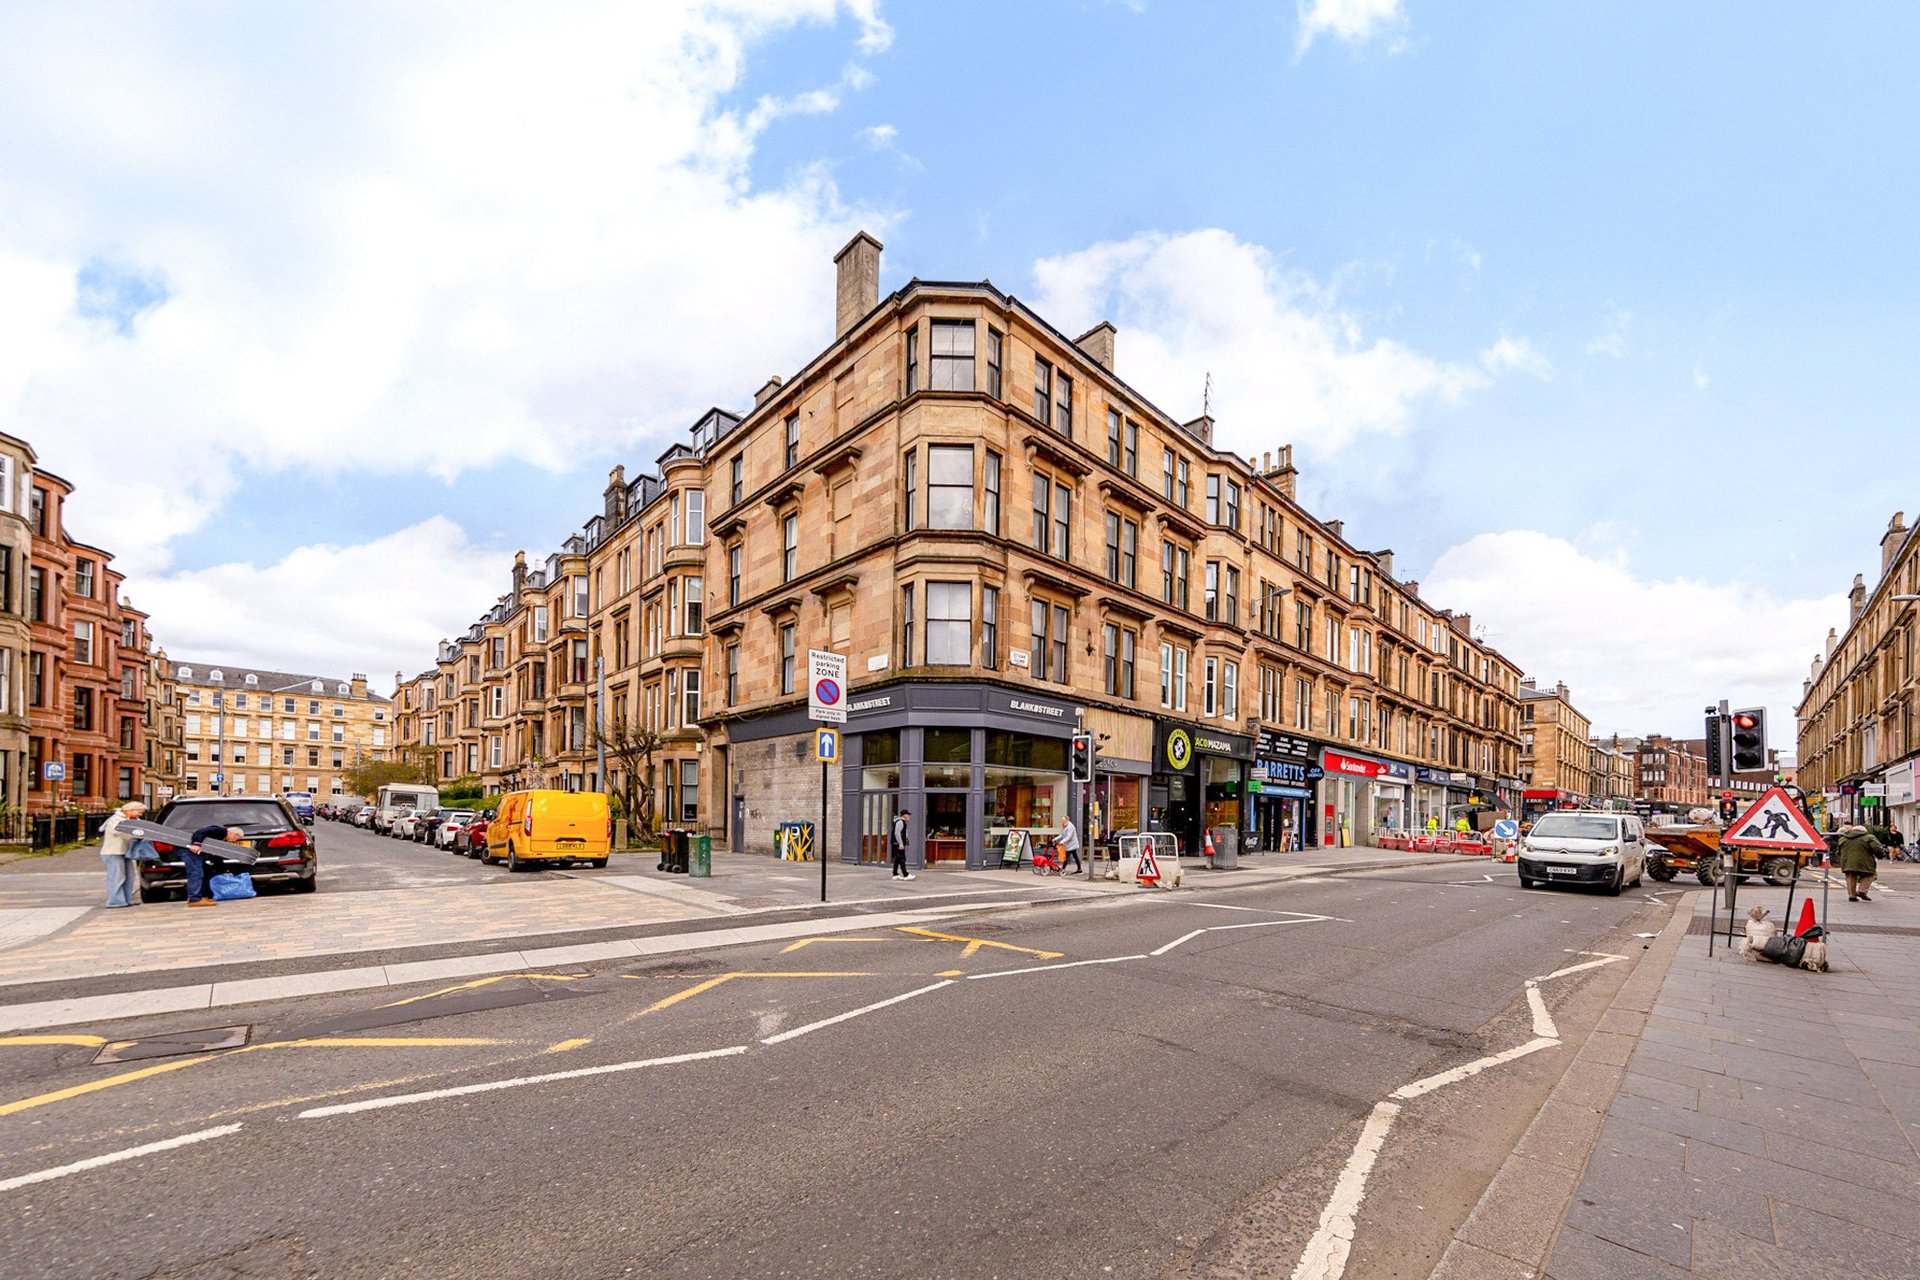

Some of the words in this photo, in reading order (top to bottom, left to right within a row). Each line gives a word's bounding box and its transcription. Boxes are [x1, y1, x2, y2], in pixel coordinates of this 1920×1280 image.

[811, 652, 844, 663] Restricted
[816, 661, 840, 670] parking
[816, 668, 840, 678] ZONE
[1256, 758, 1305, 782] BARRETTS
[1345, 761, 1366, 773] Santander
